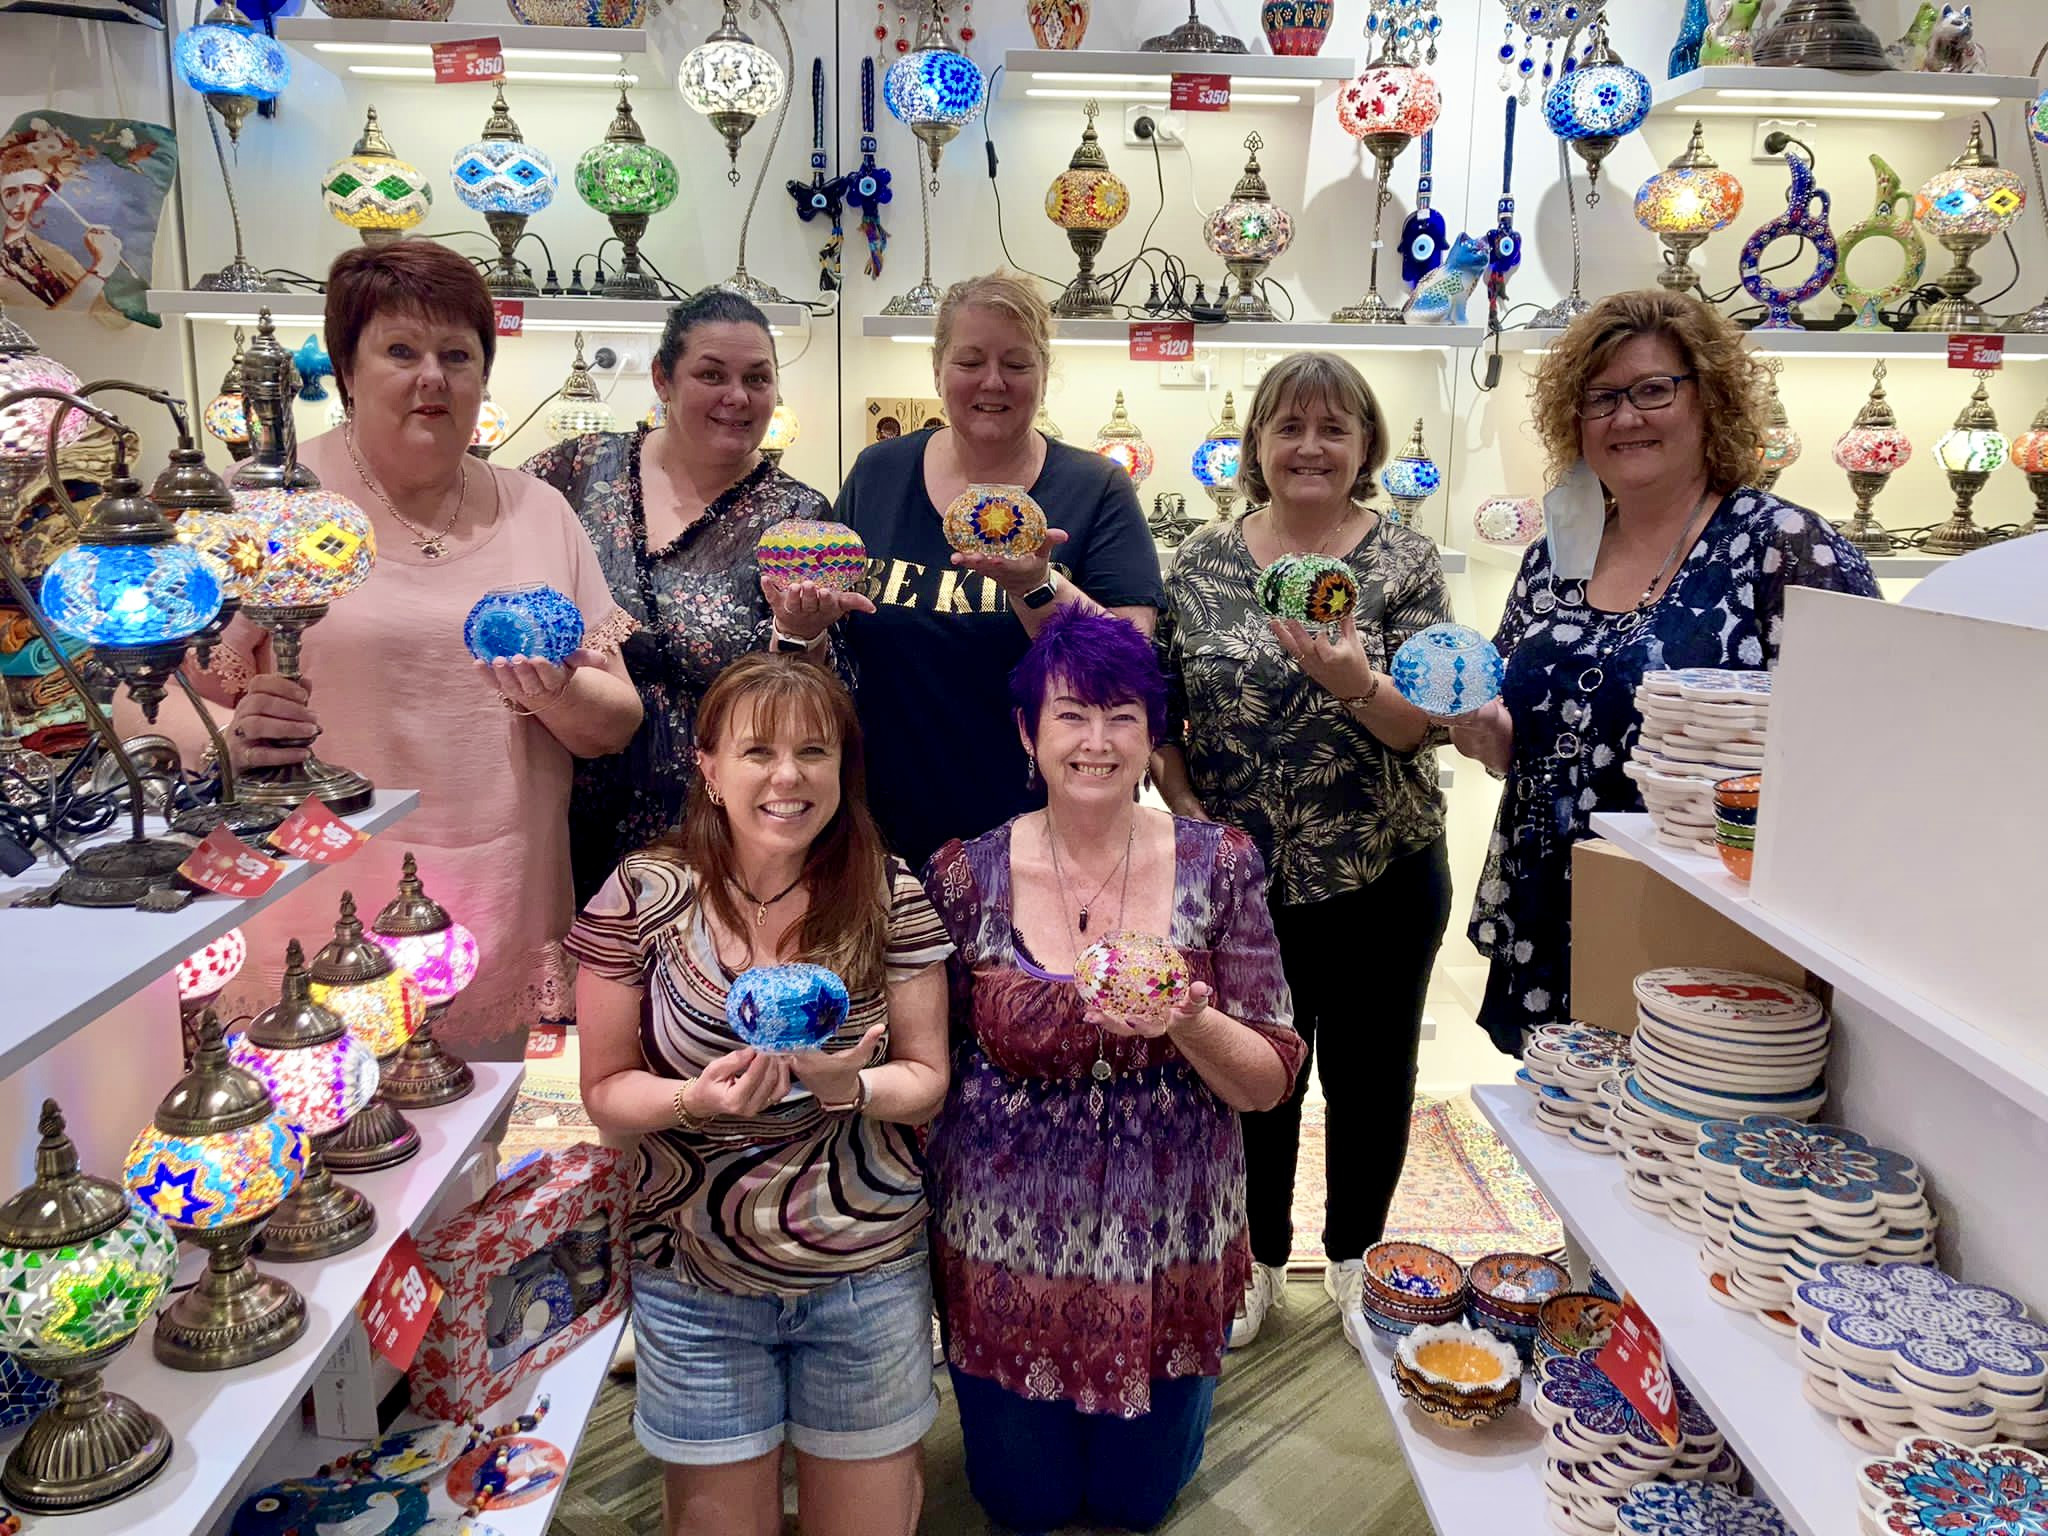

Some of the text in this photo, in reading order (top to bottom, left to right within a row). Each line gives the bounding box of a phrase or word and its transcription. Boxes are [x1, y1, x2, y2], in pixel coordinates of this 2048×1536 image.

[465, 56, 503, 76] $350
[1198, 89, 1229, 104] $350
[496, 315, 520, 329] 150
[1158, 340, 1189, 355] $120
[1973, 350, 2001, 363] $200
[866, 558, 926, 608] BE
[527, 1033, 558, 1052] $25
[400, 1265, 427, 1322] $59
[1640, 1367, 1673, 1415] $20
